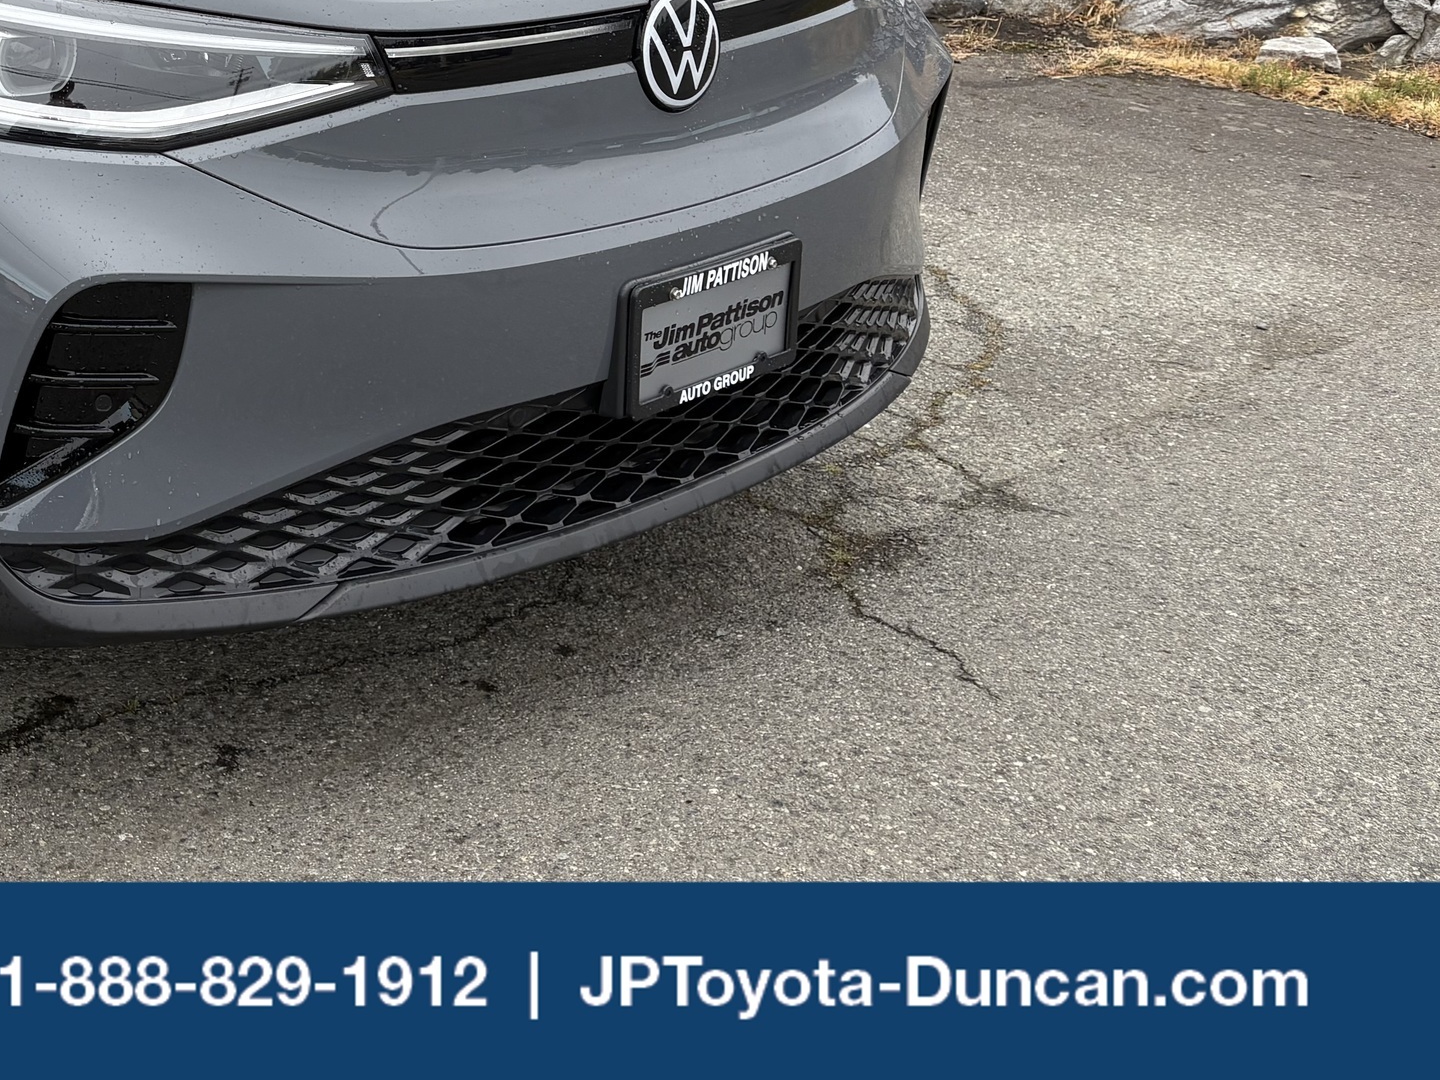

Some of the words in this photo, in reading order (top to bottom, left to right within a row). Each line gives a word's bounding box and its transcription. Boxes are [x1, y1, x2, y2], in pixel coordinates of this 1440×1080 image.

[680, 272, 704, 298] JIM
[706, 251, 770, 290] PATTISON
[695, 290, 785, 336] Pattison
[644, 329, 663, 342] The
[653, 321, 695, 351] Jim
[679, 382, 711, 405] AUTO
[713, 364, 755, 391] GROUP
